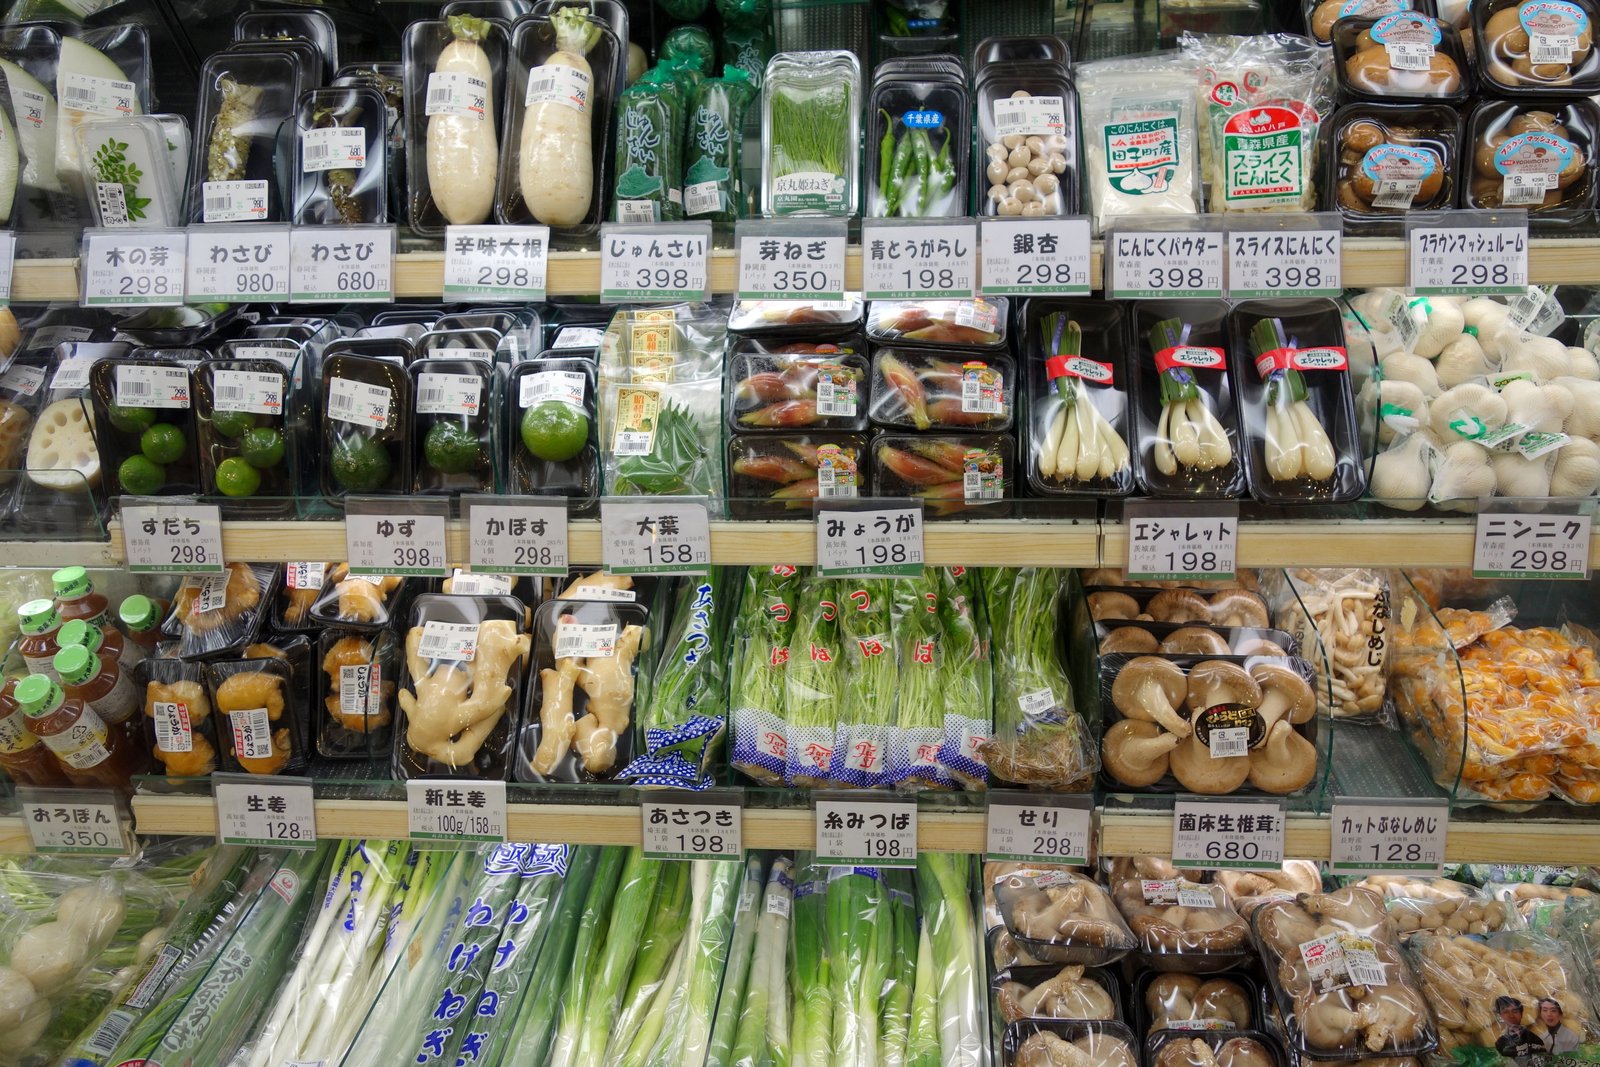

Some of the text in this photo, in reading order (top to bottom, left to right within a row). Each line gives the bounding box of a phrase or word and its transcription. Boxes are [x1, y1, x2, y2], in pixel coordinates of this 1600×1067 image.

[1541, 4, 1583, 20] マッシュルーム
[907, 112, 940, 124] 千葉県産
[1112, 140, 1172, 162] 田子町産
[1237, 134, 1289, 149] 青森県産
[1526, 136, 1568, 154] マッシュルーム
[1233, 151, 1293, 170] スライス
[777, 178, 831, 191] 京丸姫ねぎ
[1234, 167, 1292, 187] にんにく
[312, 242, 374, 261] わさび
[455, 236, 542, 258] 辛味大根
[610, 240, 702, 258] じゅんさい
[760, 241, 826, 260] 芽ねぎ
[871, 240, 967, 260] 青とうがらし
[1014, 233, 1058, 254] 銀杏
[1119, 238, 1218, 257] にんにくパウダー
[1236, 236, 1335, 256] スライスにんにく
[1420, 233, 1523, 253] ブラウンマッシュルーム
[106, 247, 168, 267] 木の芽
[210, 245, 272, 263] わさび
[1180, 354, 1214, 362] エシャレット
[1072, 364, 1104, 378] エシャレット
[142, 518, 200, 535] すだち
[377, 520, 416, 537] ゆず
[486, 518, 548, 536] かぼす
[637, 515, 679, 535] 大葉
[827, 514, 915, 537] みょうが
[1135, 522, 1230, 541] エシャレット
[1486, 520, 1580, 539] ニンニク
[247, 795, 286, 813] 生姜
[426, 788, 486, 807] 新生姜
[33, 808, 111, 824] おろぽん
[650, 808, 732, 826] あさつき
[824, 811, 910, 830] 糸みつば
[1019, 810, 1058, 827] せり
[1180, 813, 1274, 833] 菌床生椎茸
[1342, 817, 1437, 834] カットぶなしめじ
[417, 897, 494, 1065] わけねぎ
